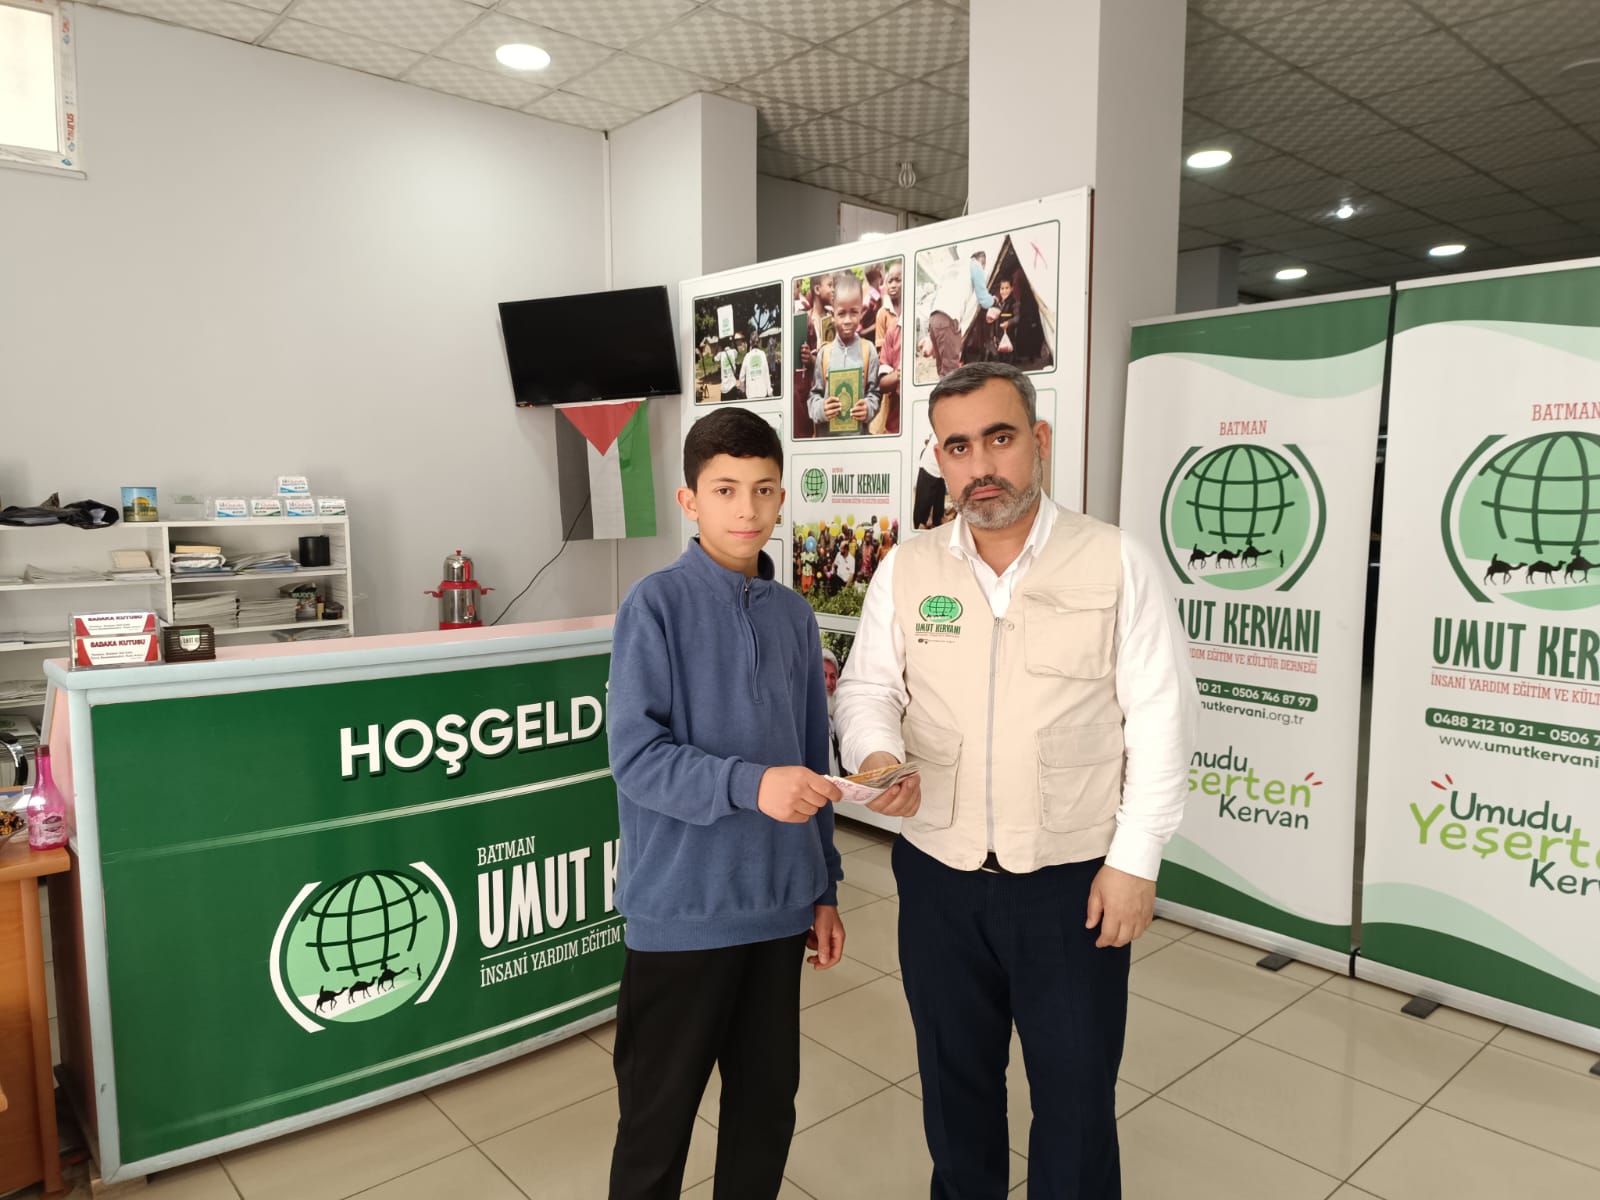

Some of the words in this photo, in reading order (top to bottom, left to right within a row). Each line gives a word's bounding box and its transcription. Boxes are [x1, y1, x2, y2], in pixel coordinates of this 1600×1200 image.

[1219, 420, 1267, 436] BATMAN
[831, 474, 855, 494] UMUT
[856, 473, 890, 495] KERVANI
[916, 623, 934, 632] UMUT
[1223, 602, 1321, 654] KERVANI
[1235, 654, 1246, 664] VE
[1433, 617, 1526, 672] UMUT
[1537, 625, 1600, 681] KER
[1211, 684, 1221, 694] 21
[1232, 687, 1259, 700] 0506
[1261, 691, 1280, 703] 746
[1282, 694, 1296, 705] 87
[1297, 696, 1312, 708] 97
[1469, 678, 1510, 695] YARDIM
[1554, 688, 1569, 702] VE
[340, 682, 608, 777] HOŞGELD
[1432, 712, 1469, 728] 0488
[1471, 717, 1495, 732] 212
[1498, 721, 1515, 734] 10
[1518, 725, 1534, 737] 21
[1549, 729, 1590, 745] 0506
[1218, 793, 1309, 830] Kervan
[1450, 790, 1572, 834] Umudu
[477, 835, 536, 867] BATMAN
[1409, 802, 1600, 869] Yeşert
[1529, 858, 1600, 896] Ker
[478, 846, 591, 949] UMUT
[480, 951, 529, 988] İNSANİ
[530, 939, 579, 971] YARDIM
[581, 924, 621, 955] EĞİTİM
